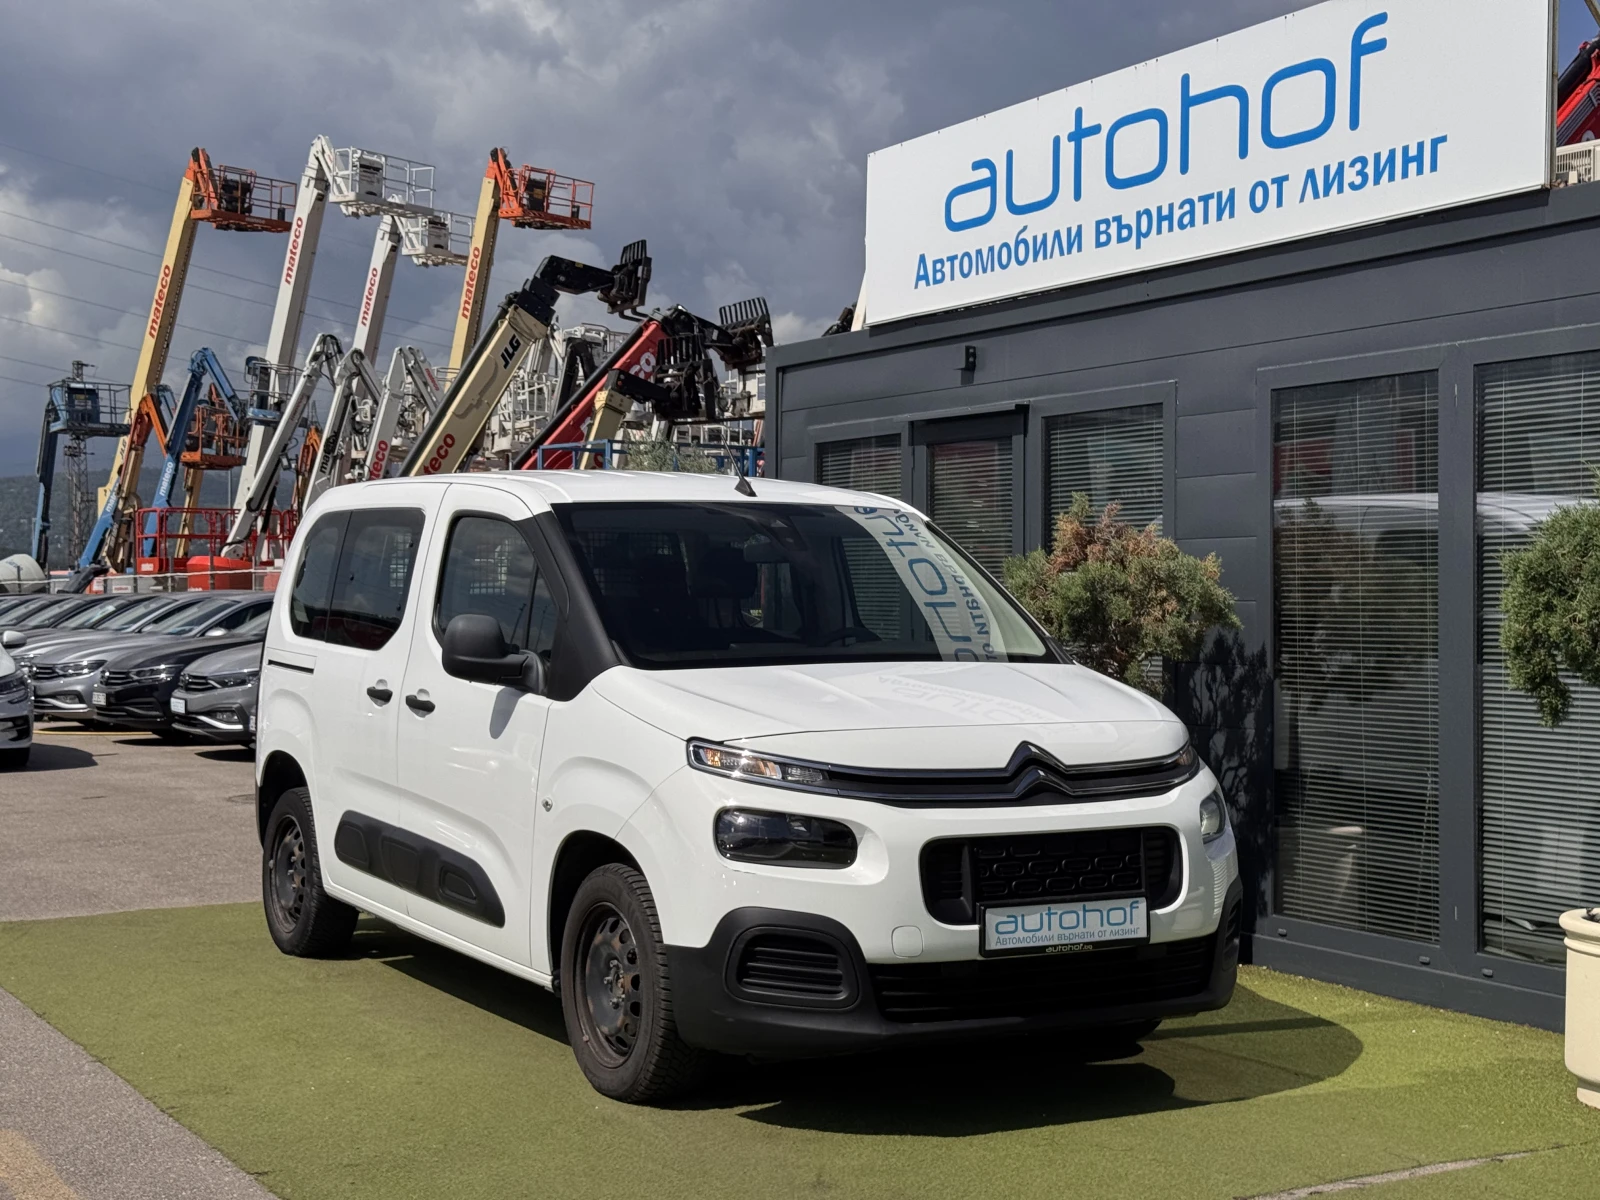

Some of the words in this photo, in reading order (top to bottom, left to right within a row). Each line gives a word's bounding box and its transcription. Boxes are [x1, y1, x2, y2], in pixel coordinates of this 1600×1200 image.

[944, 11, 1389, 233] autohof
[913, 223, 1084, 290] Автомобили
[1094, 187, 1236, 251] върнати
[1248, 174, 1290, 215] от
[1299, 134, 1449, 205] лизинг
[284, 216, 304, 286] mateco
[149, 264, 172, 340] mateco
[360, 266, 379, 328] mateco
[461, 246, 481, 320] mateco
[500, 333, 522, 370] JLG
[159, 461, 174, 496] mateco
[369, 440, 389, 480] teco
[994, 900, 1140, 935] autohof
[995, 932, 1055, 947] Автомобили
[1057, 930, 1095, 942] върнати
[1097, 929, 1107, 938] от
[1109, 927, 1140, 937] лизинг
